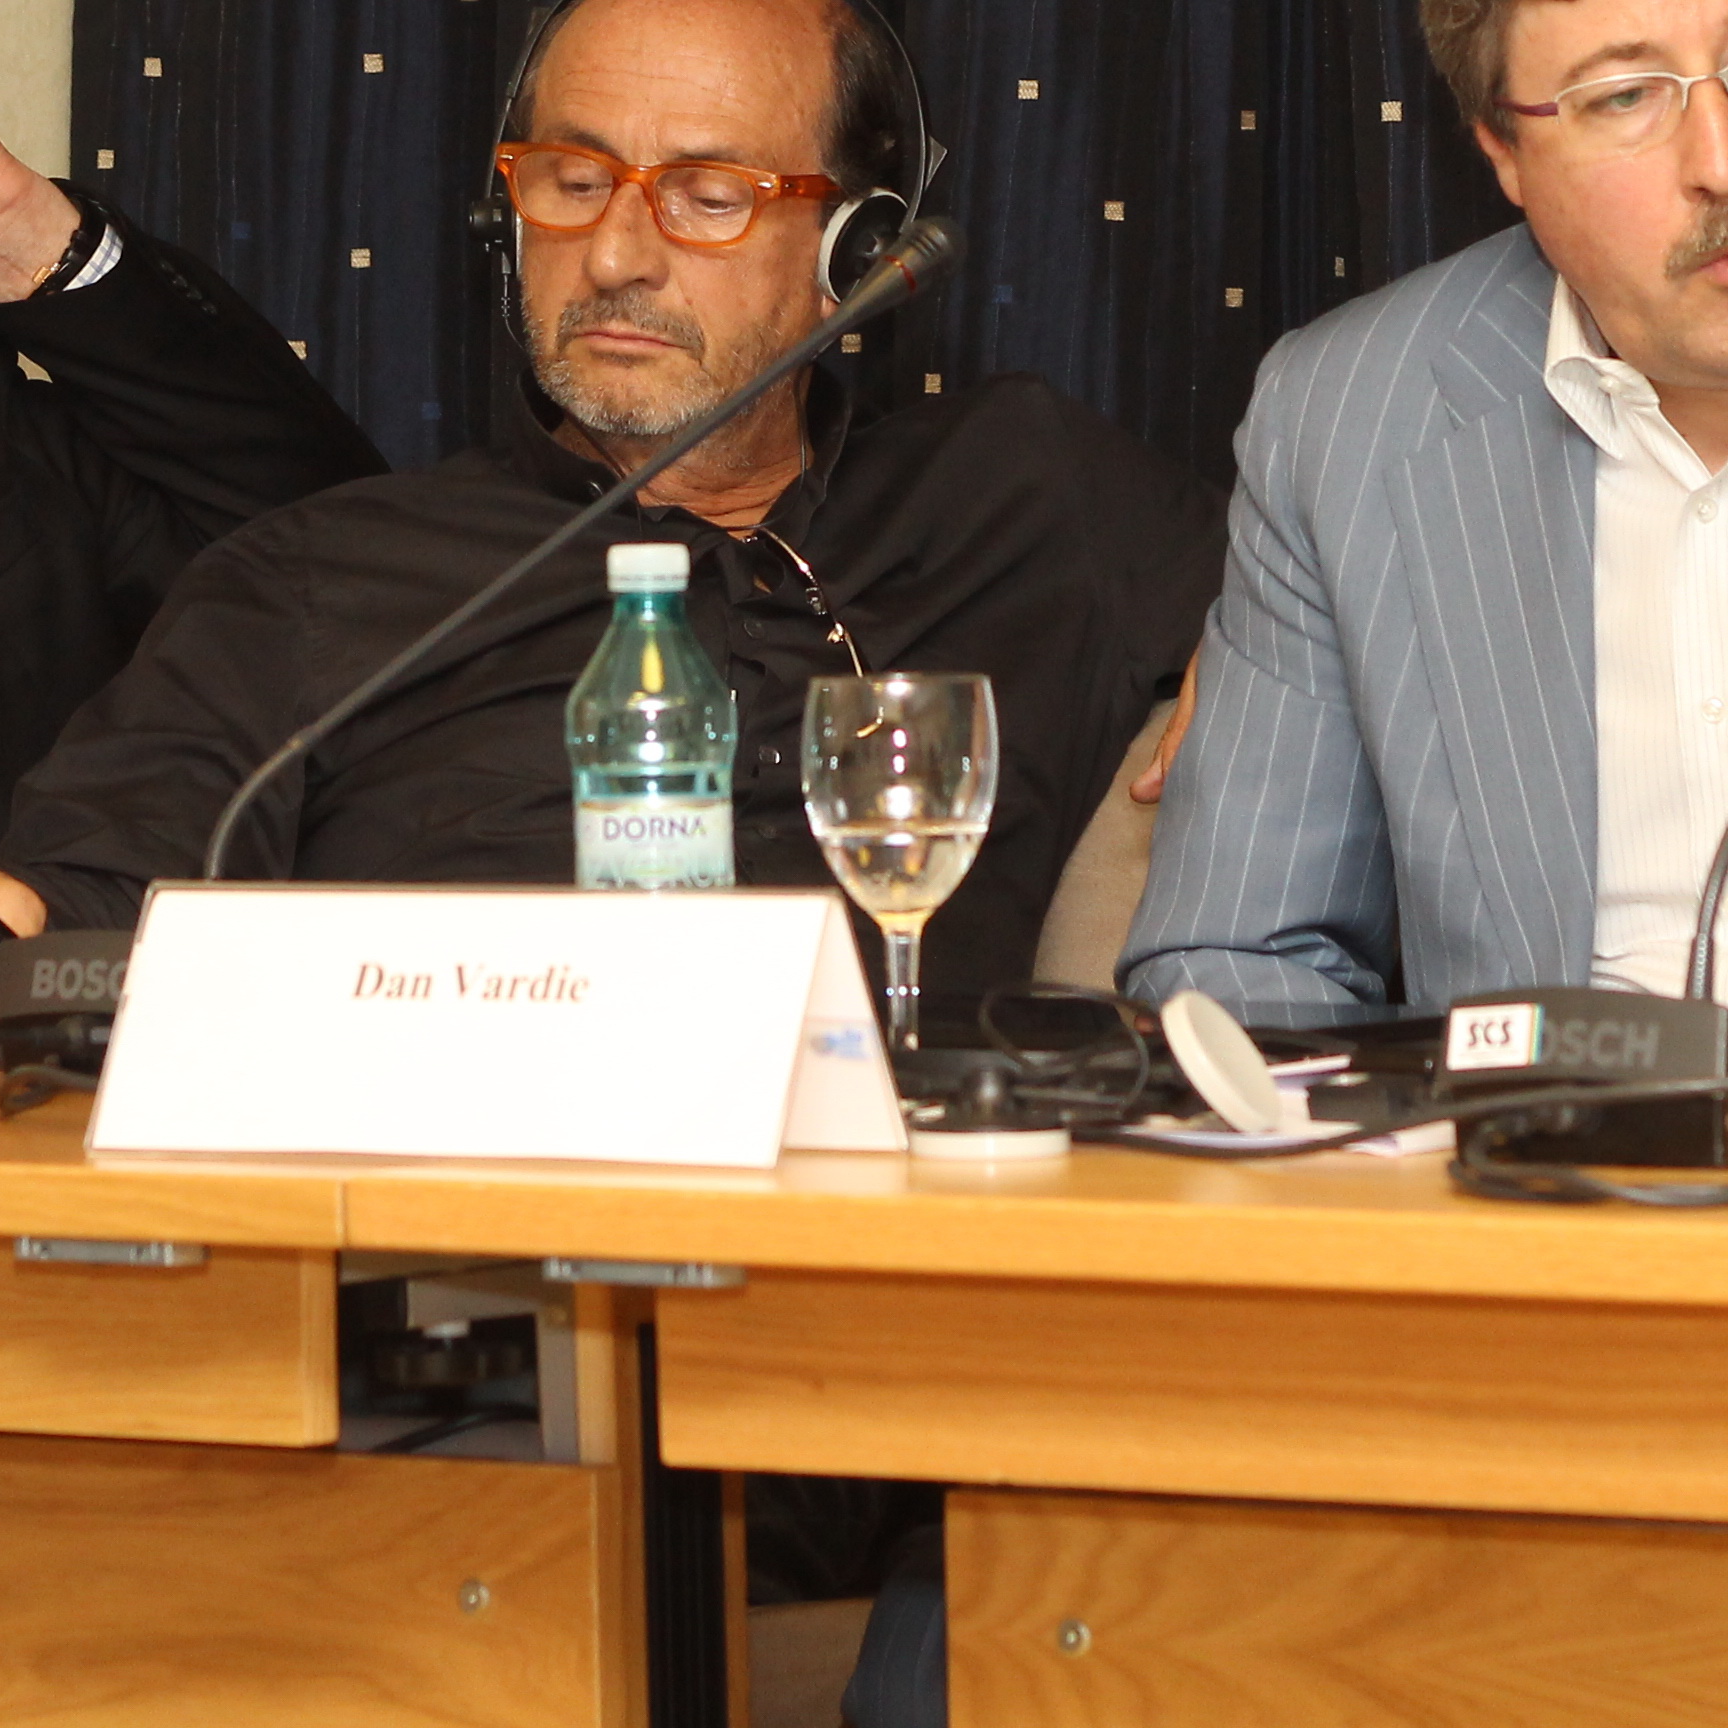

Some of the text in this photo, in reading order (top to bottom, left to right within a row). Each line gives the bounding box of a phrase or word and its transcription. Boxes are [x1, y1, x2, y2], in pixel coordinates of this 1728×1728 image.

[602, 816, 708, 841] DORNA
[352, 962, 432, 1000] Dan
[1467, 1021, 1512, 1048] SCS
